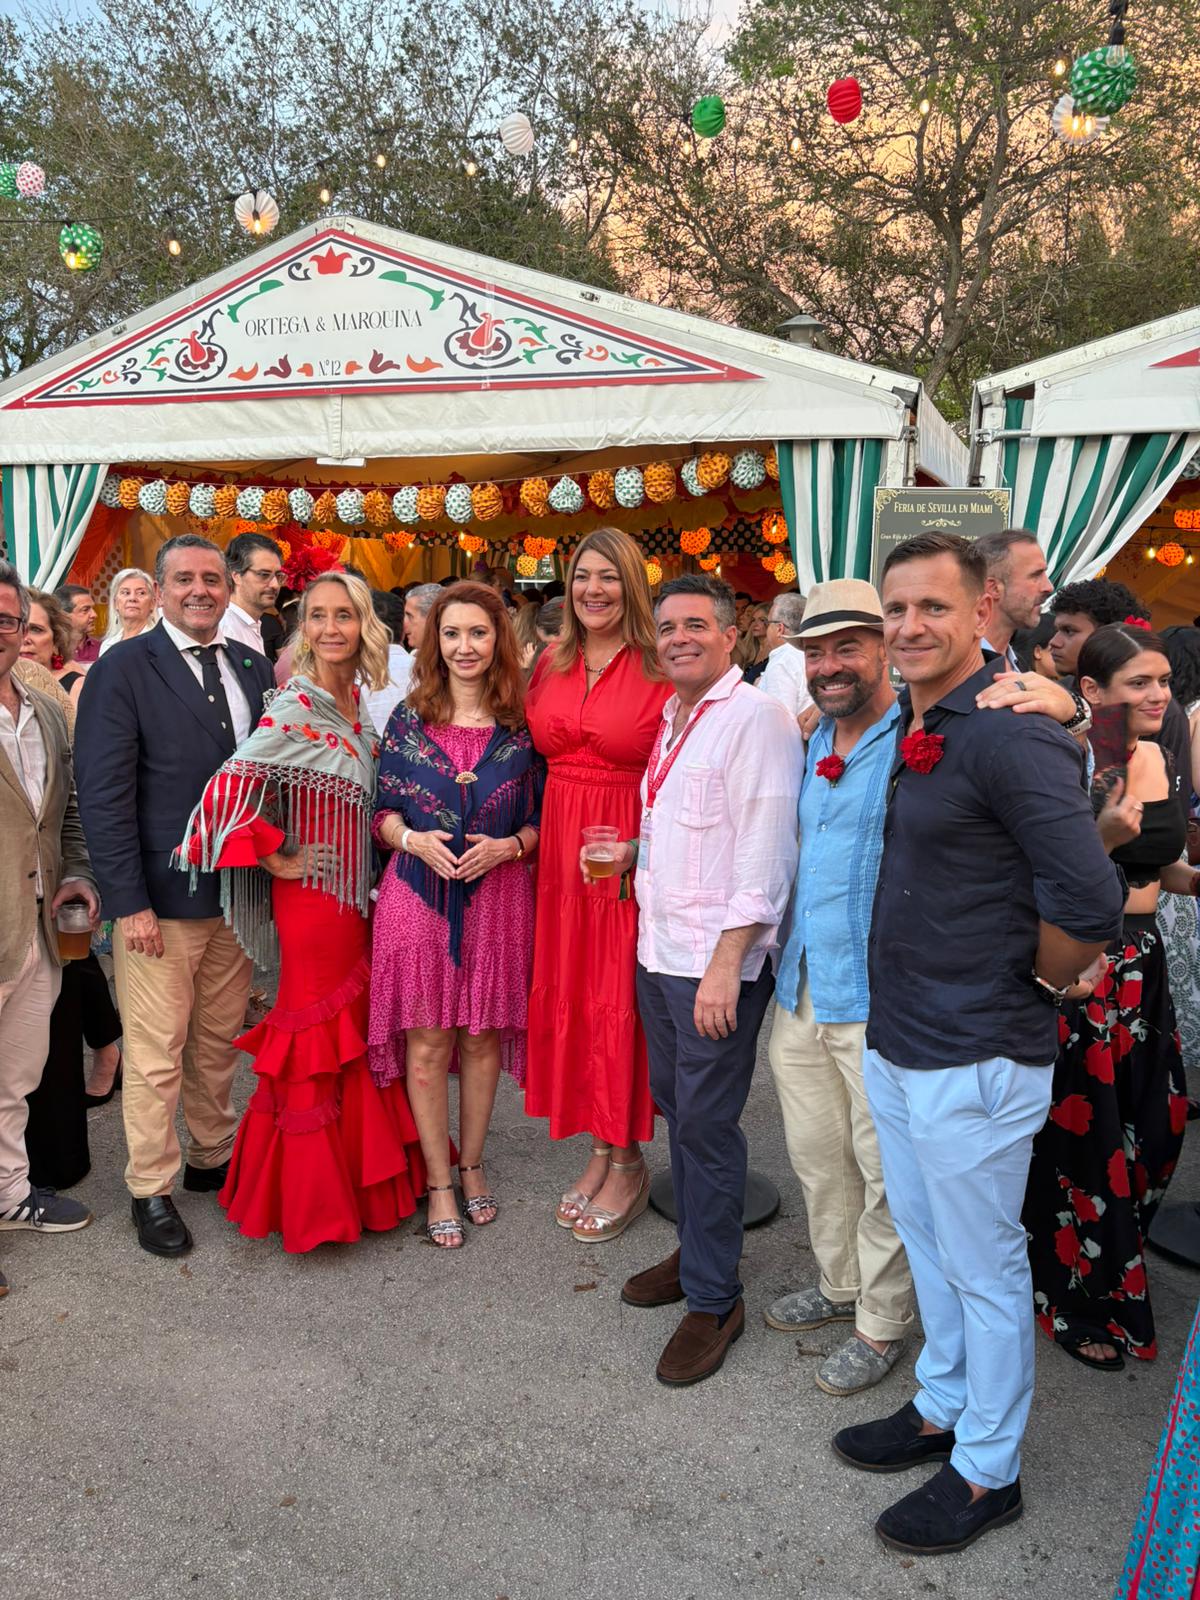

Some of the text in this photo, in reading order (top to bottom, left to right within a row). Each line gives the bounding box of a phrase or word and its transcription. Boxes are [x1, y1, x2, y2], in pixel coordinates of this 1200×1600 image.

[245, 309, 422, 337] ORTEGA & MARQUINA
[894, 502, 993, 514] FERIA DE SEVILLA EN MIAMI
